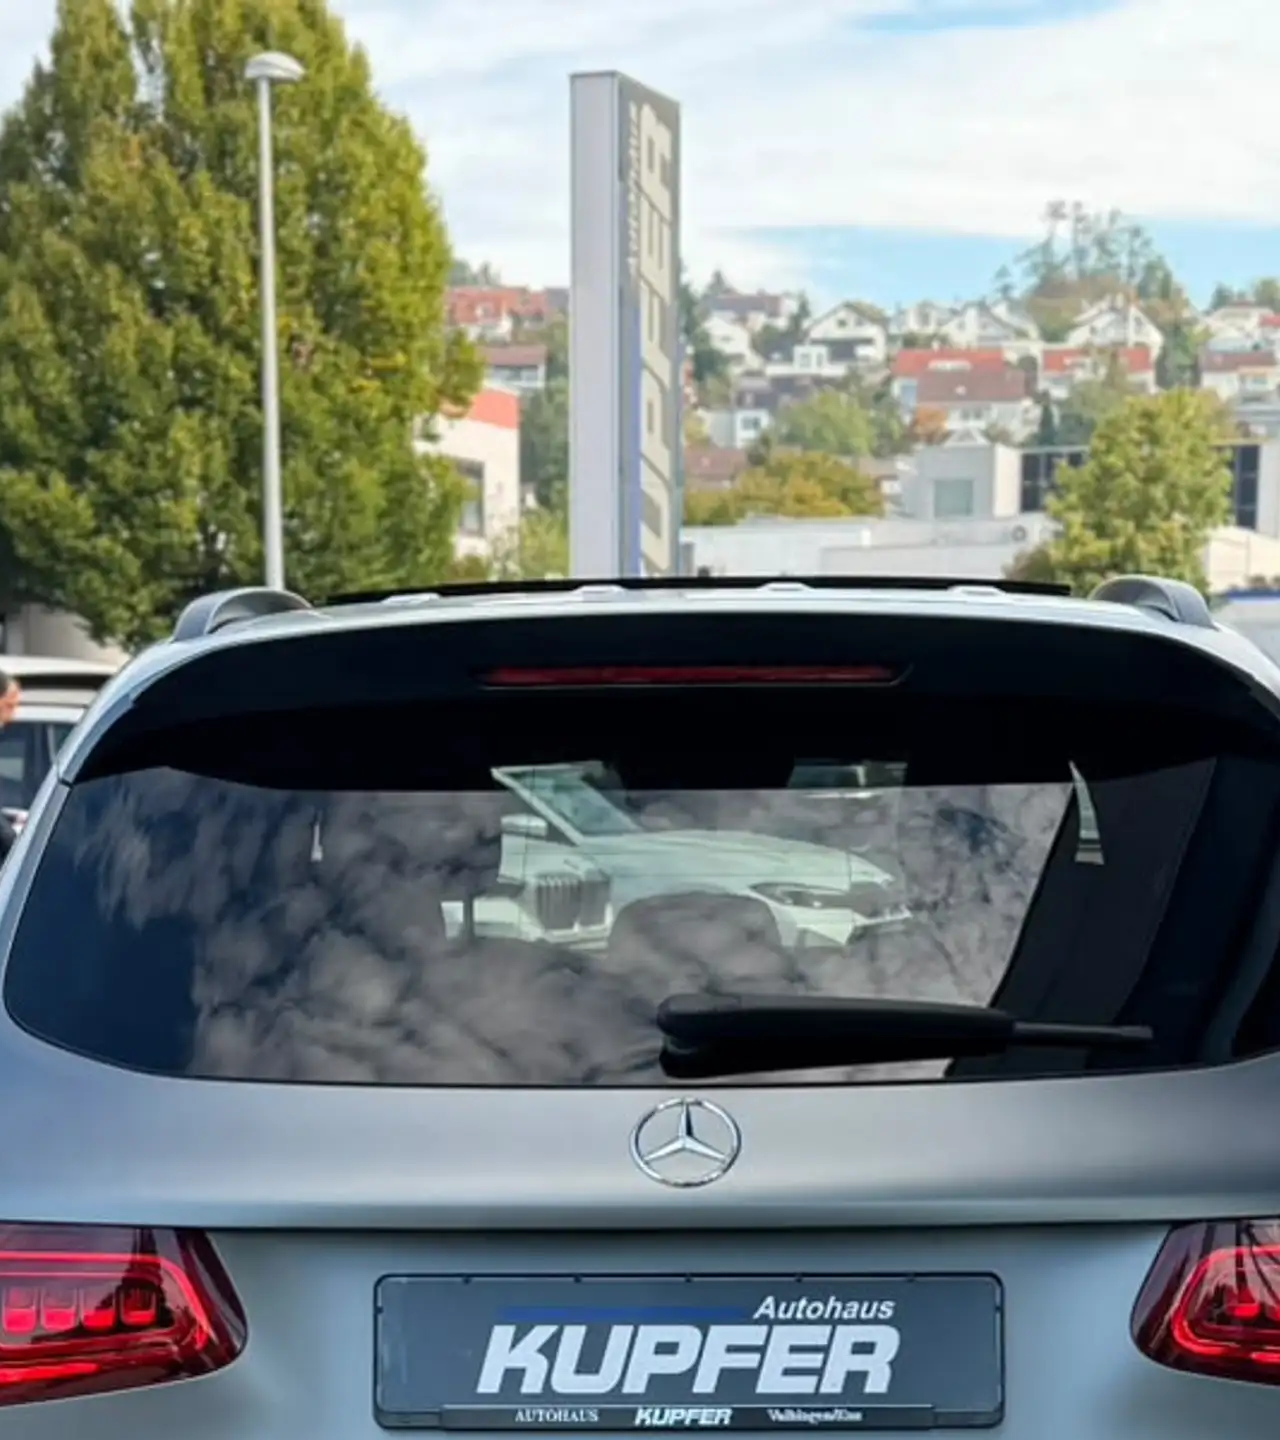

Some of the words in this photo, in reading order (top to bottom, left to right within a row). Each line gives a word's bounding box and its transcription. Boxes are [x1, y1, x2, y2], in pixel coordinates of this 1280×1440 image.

[639, 102, 671, 577] UPFER
[753, 1296, 895, 1320] Autohaus
[476, 1324, 901, 1394] KUPFER
[515, 1409, 599, 1422] AUTOHAUS
[633, 1407, 733, 1426] KUPFER
